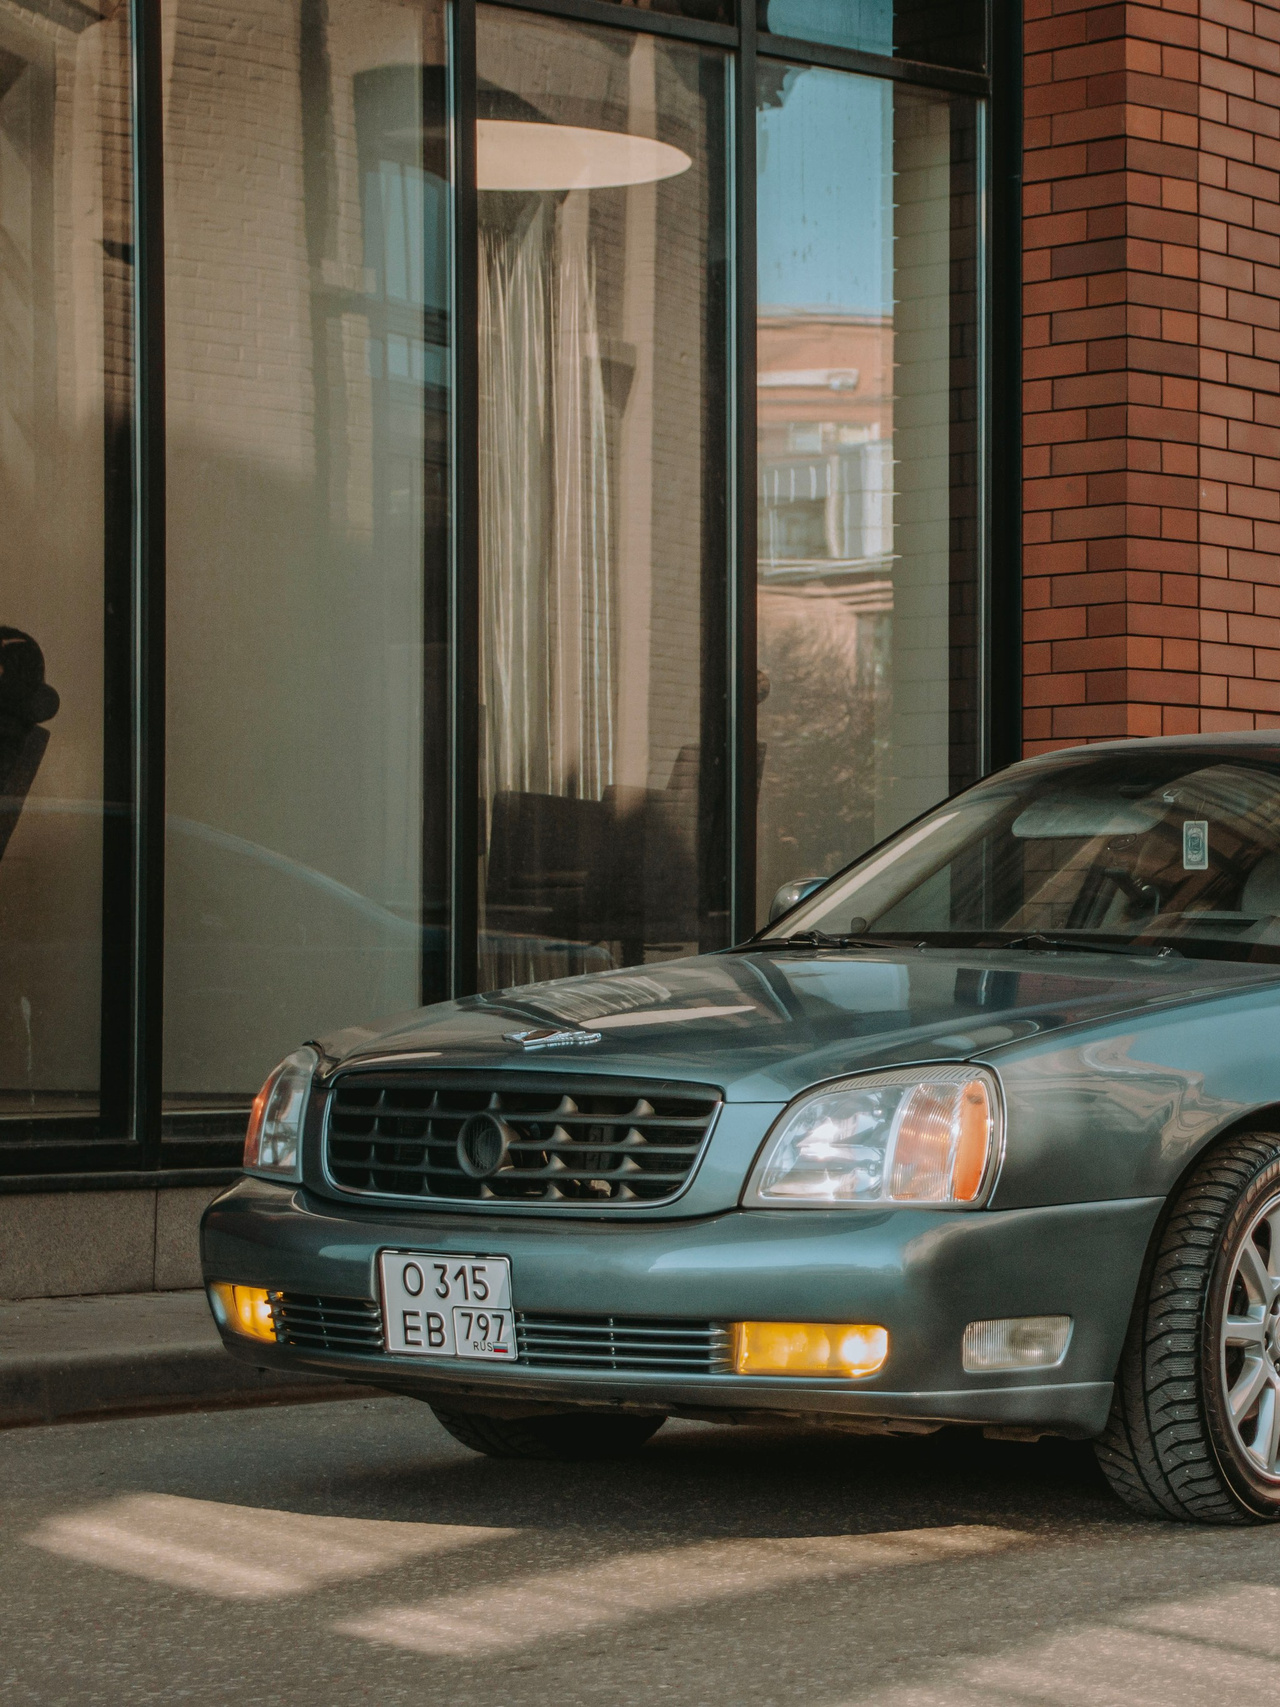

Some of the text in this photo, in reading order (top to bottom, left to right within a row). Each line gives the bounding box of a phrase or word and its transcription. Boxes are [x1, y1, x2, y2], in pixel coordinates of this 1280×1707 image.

[433, 1263, 490, 1301] 315
[460, 1312, 505, 1342] 797
[473, 1341, 493, 1352] RUS
